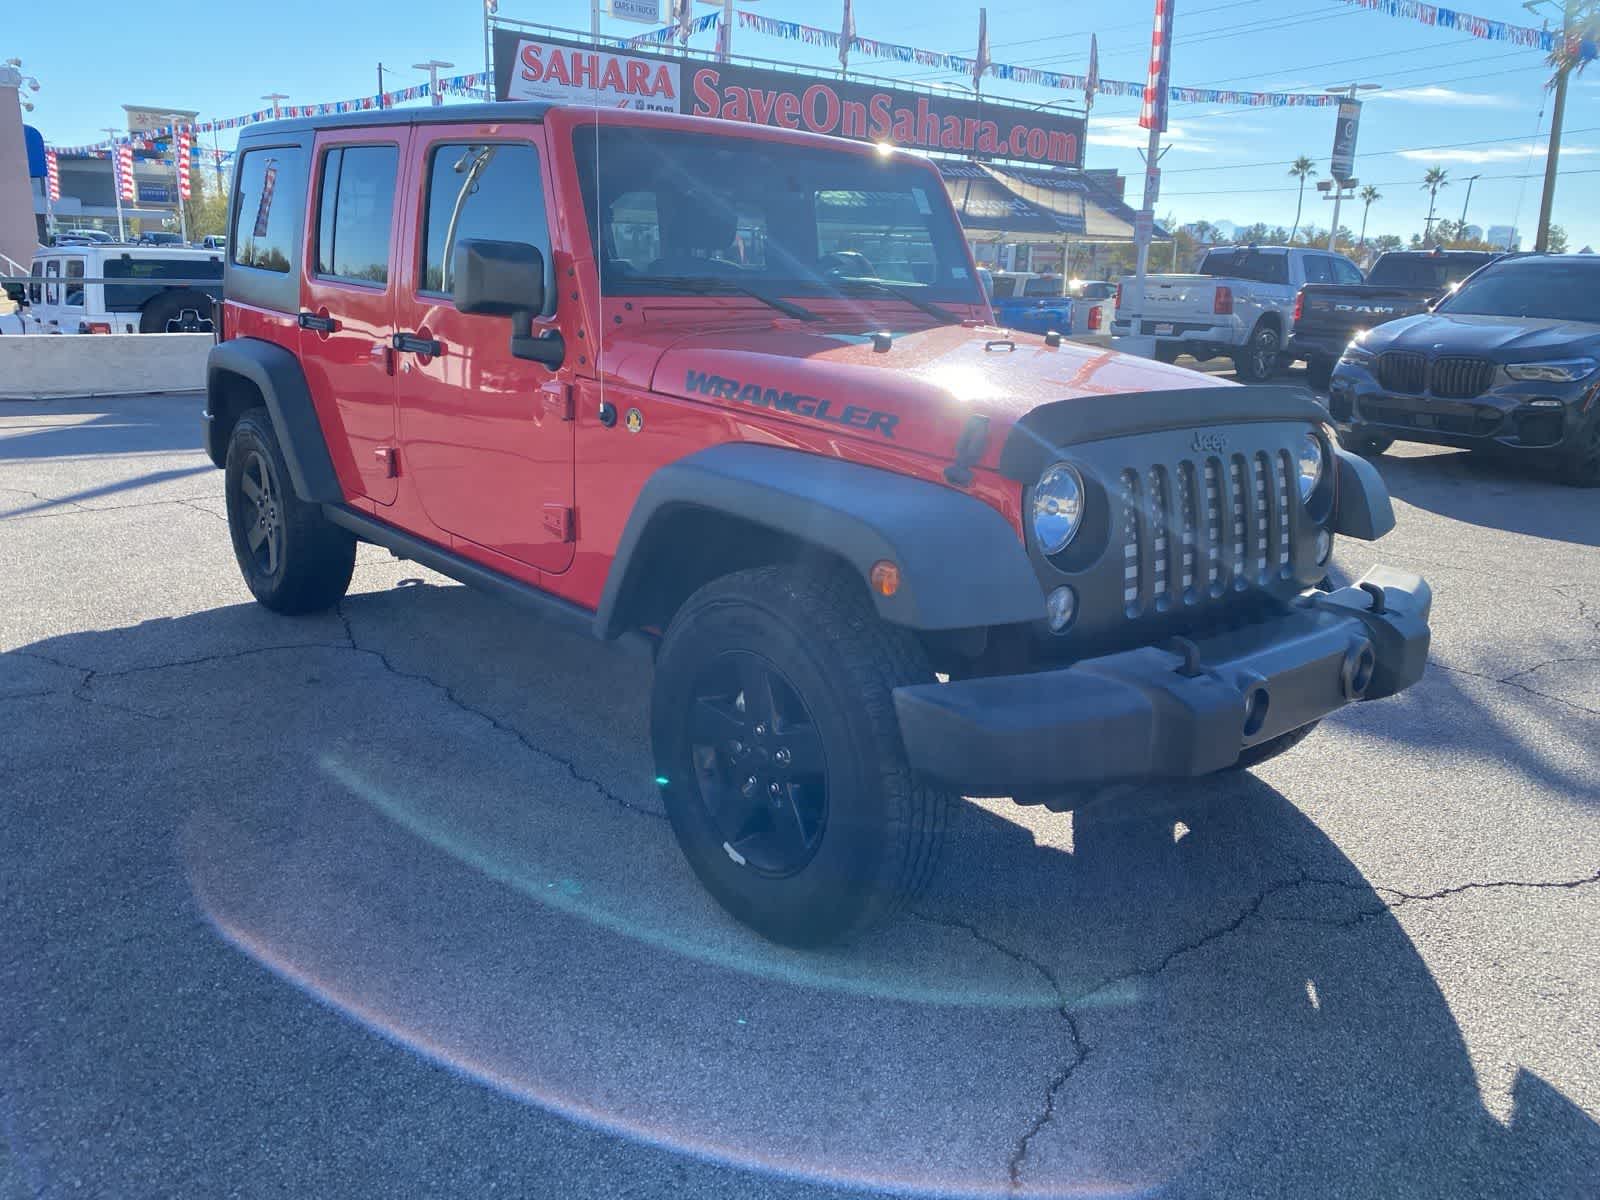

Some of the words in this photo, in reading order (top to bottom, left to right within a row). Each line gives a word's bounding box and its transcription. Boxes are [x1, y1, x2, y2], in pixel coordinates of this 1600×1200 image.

[520, 44, 676, 99] SAHARA
[692, 68, 1077, 165] SaveOnSahara.com
[1334, 304, 1394, 314] RAM
[685, 369, 899, 438] WRANGLER
[1191, 431, 1227, 455] Jeep
